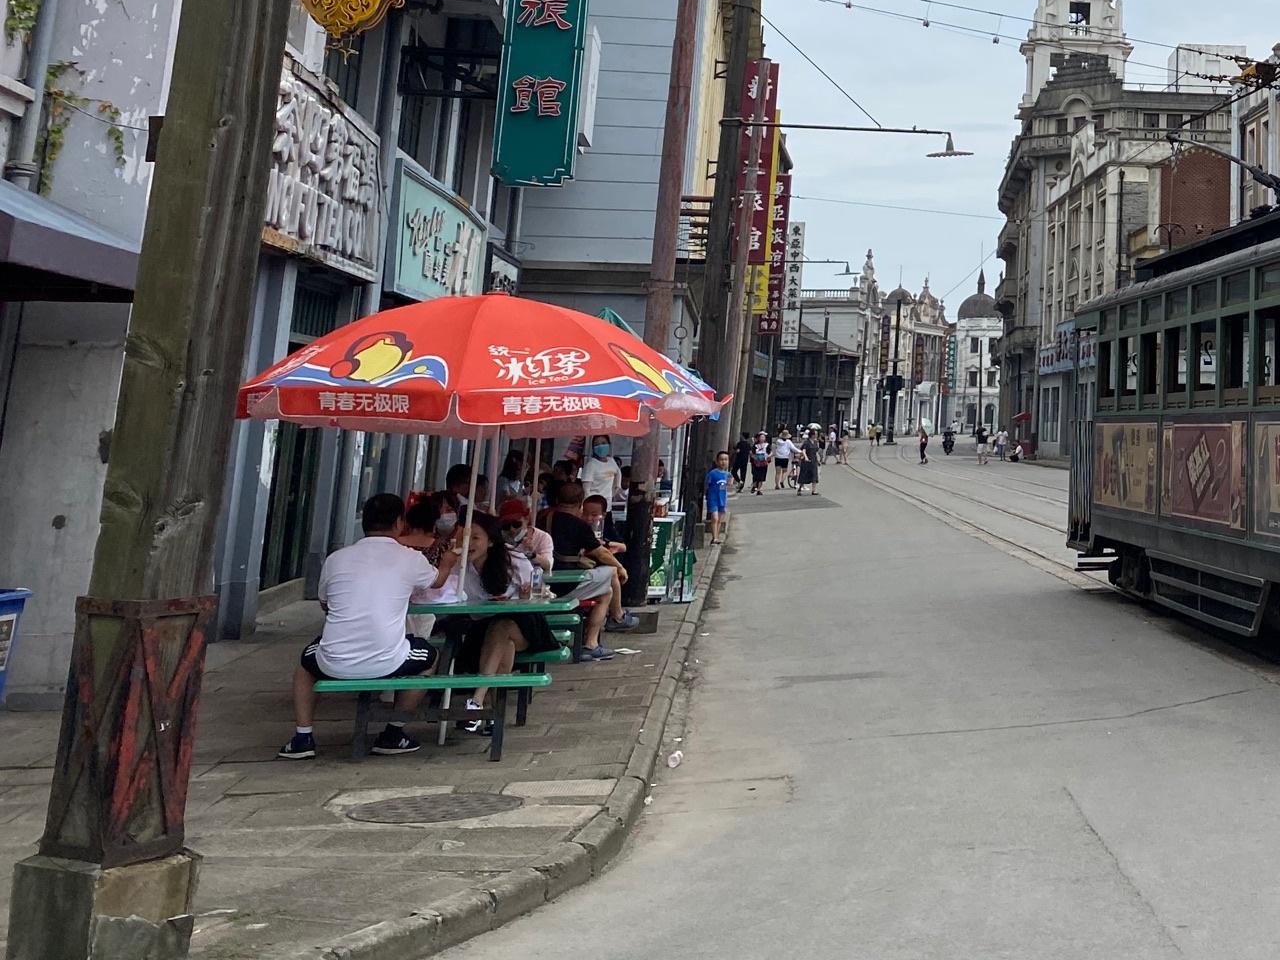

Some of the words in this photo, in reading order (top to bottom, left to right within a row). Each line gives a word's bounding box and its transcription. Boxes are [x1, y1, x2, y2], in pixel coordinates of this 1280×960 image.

[488, 344, 529, 357] 统一
[492, 347, 591, 386] 冰红茶
[318, 391, 410, 414] 青春无极限
[502, 395, 601, 415] 青春无极限
